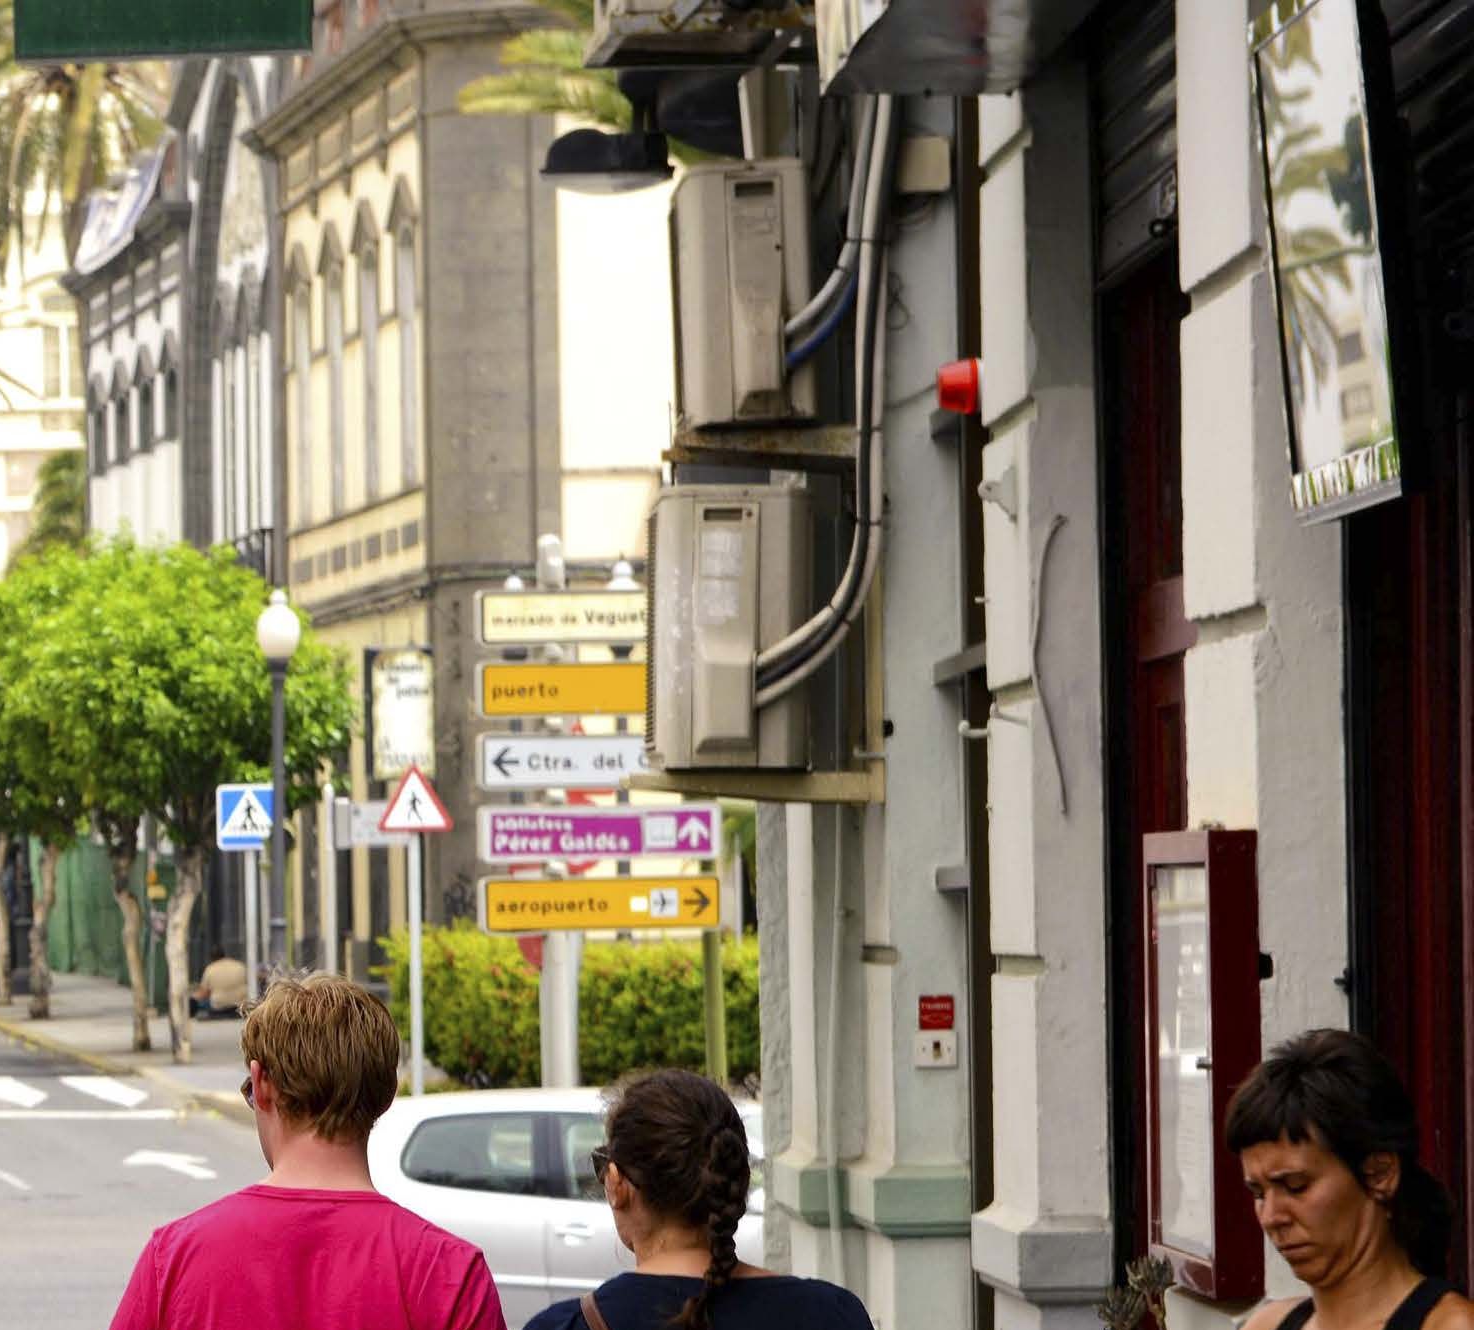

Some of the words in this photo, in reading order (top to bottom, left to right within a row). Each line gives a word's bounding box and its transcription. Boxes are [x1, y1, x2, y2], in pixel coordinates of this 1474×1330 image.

[561, 612, 577, 626] de
[584, 609, 647, 627] Veguet
[492, 682, 559, 700] puerto
[527, 752, 579, 771] Ctra.
[593, 752, 624, 769] del
[495, 815, 573, 832] biblioteca
[496, 897, 608, 917] aeropuerto
